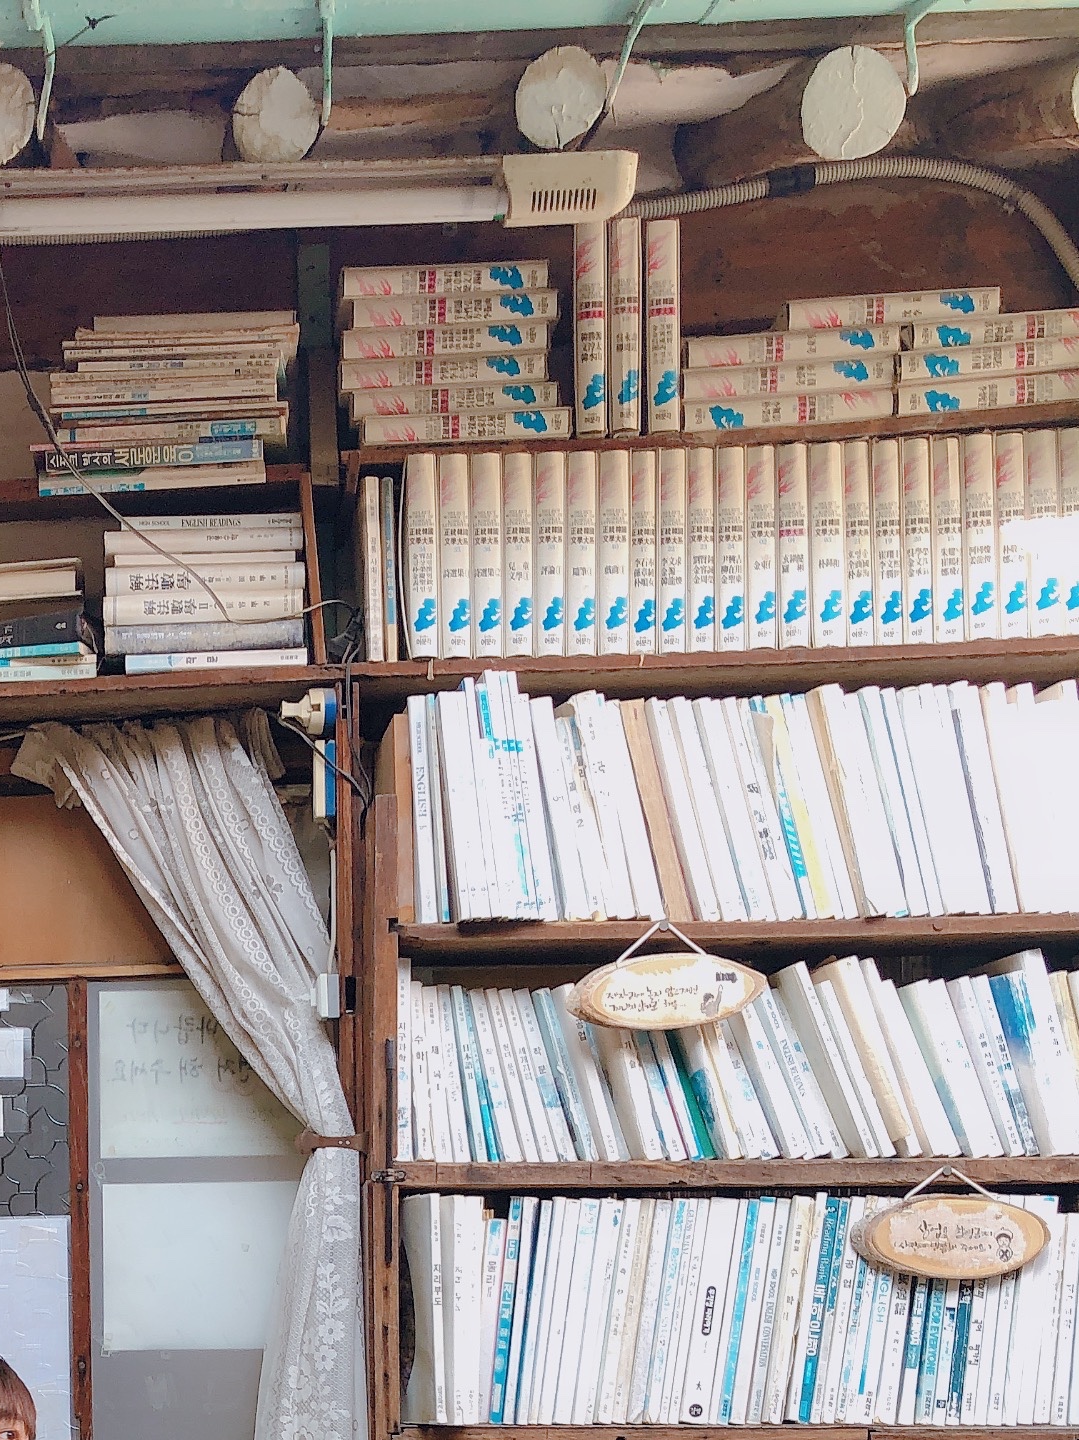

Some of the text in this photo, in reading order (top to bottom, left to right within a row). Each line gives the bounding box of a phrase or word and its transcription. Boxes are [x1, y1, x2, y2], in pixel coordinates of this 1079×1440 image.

[181, 518, 209, 527] ENGLISH
[209, 517, 241, 527] READINGS
[416, 766, 427, 818] ENGLISH
[821, 1217, 835, 1256] Reading
[433, 1264, 442, 1306] 지리부도
